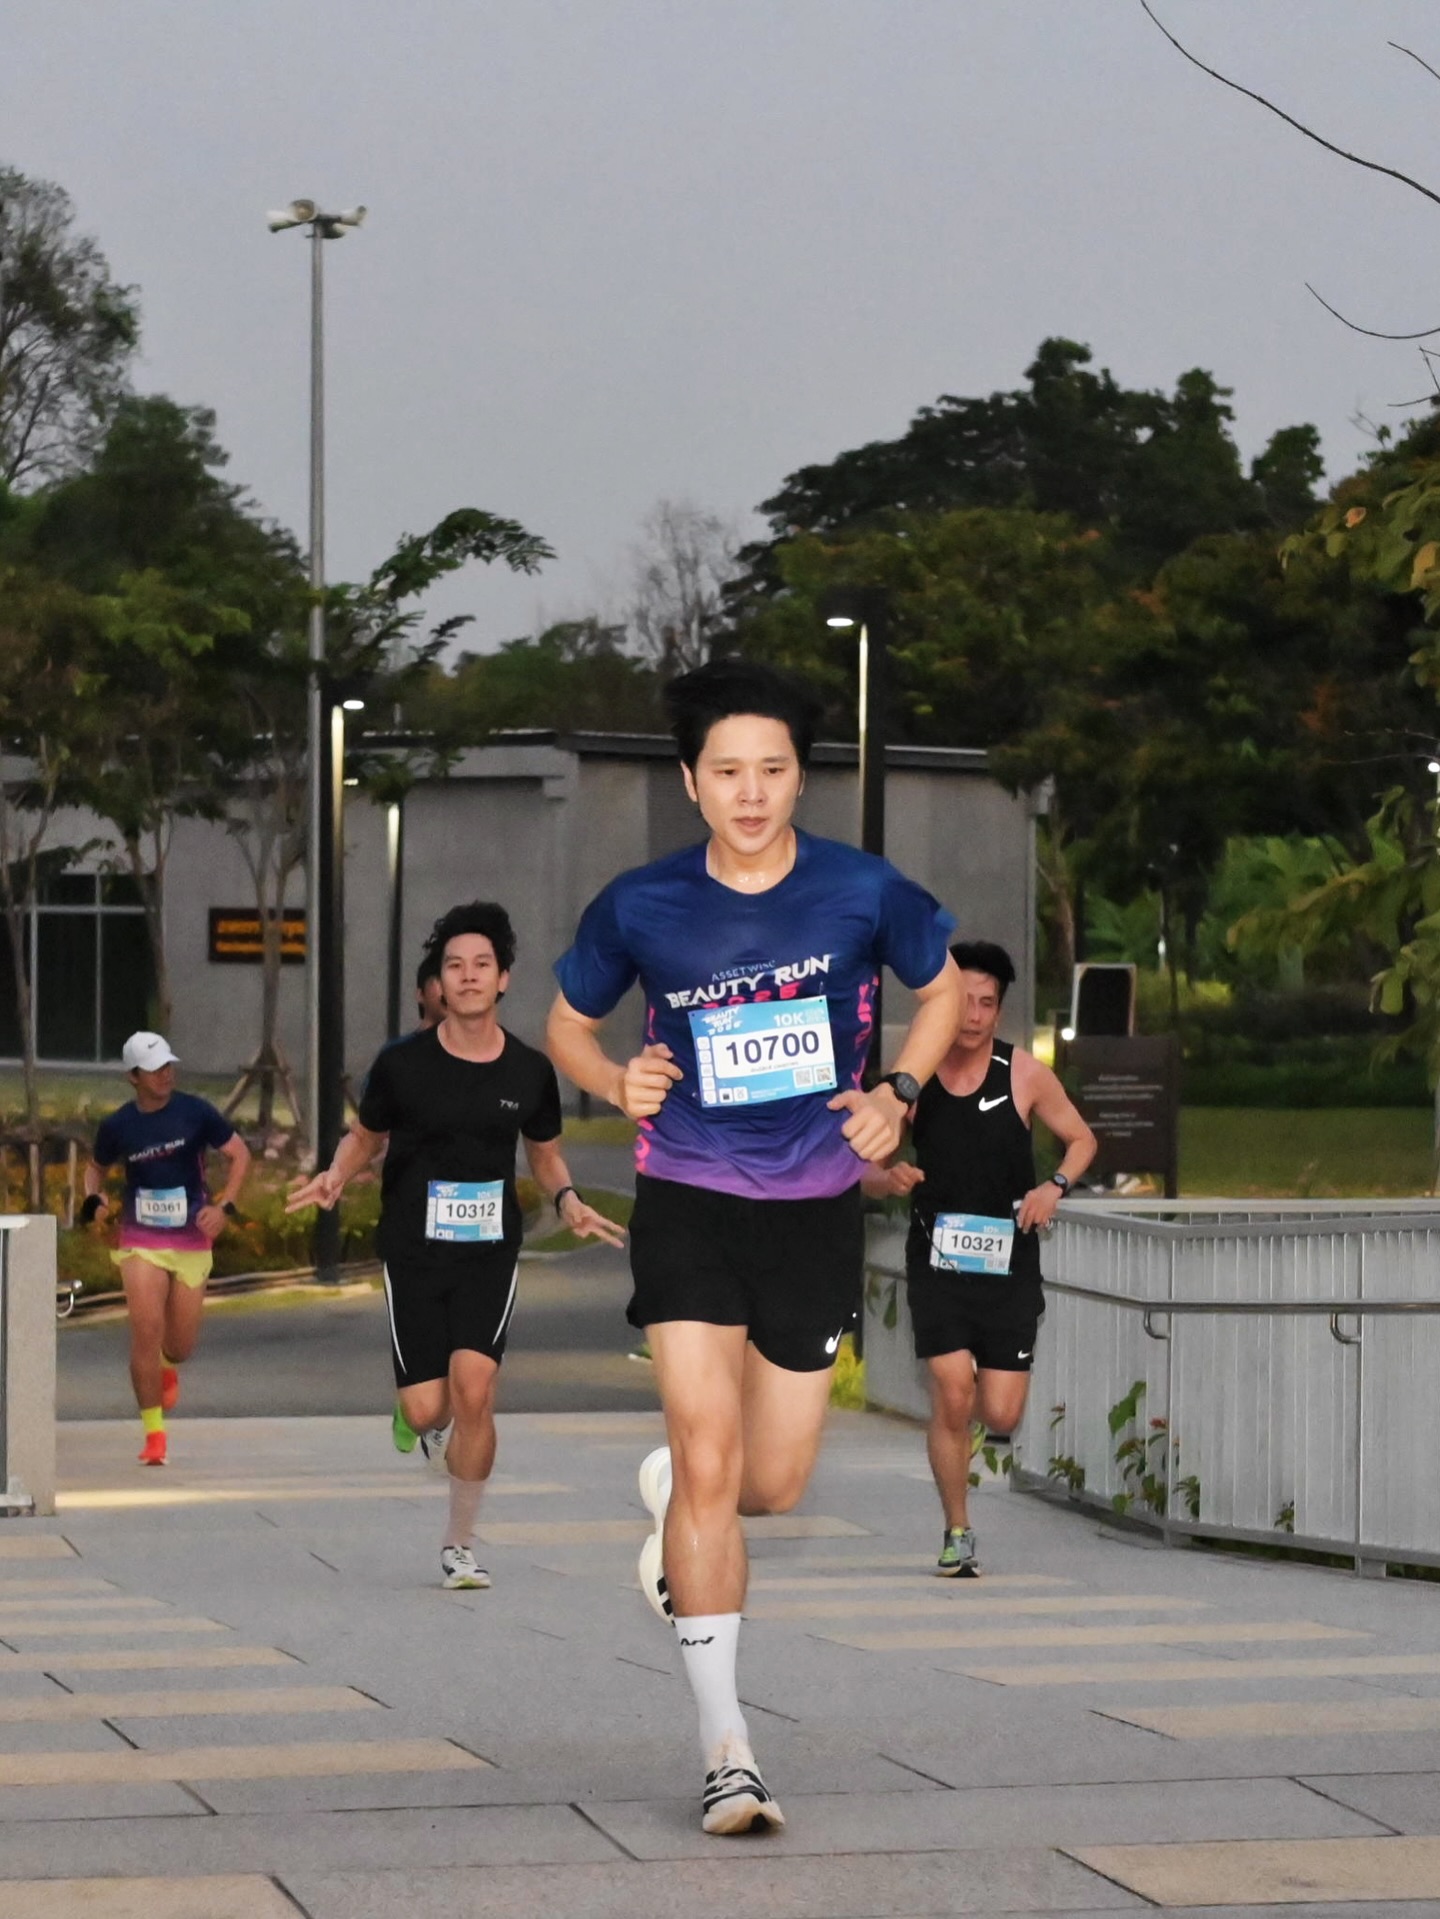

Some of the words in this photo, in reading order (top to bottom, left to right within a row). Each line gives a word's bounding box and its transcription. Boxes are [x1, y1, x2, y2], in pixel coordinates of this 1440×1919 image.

[665, 972, 765, 1009] BEAUTY
[774, 954, 832, 986] RUN
[774, 1011, 805, 1027] 10K
[725, 1030, 819, 1066] 10700
[145, 1202, 181, 1213] 10361
[446, 1202, 496, 1218] 10312
[951, 1234, 1003, 1253] 10321
